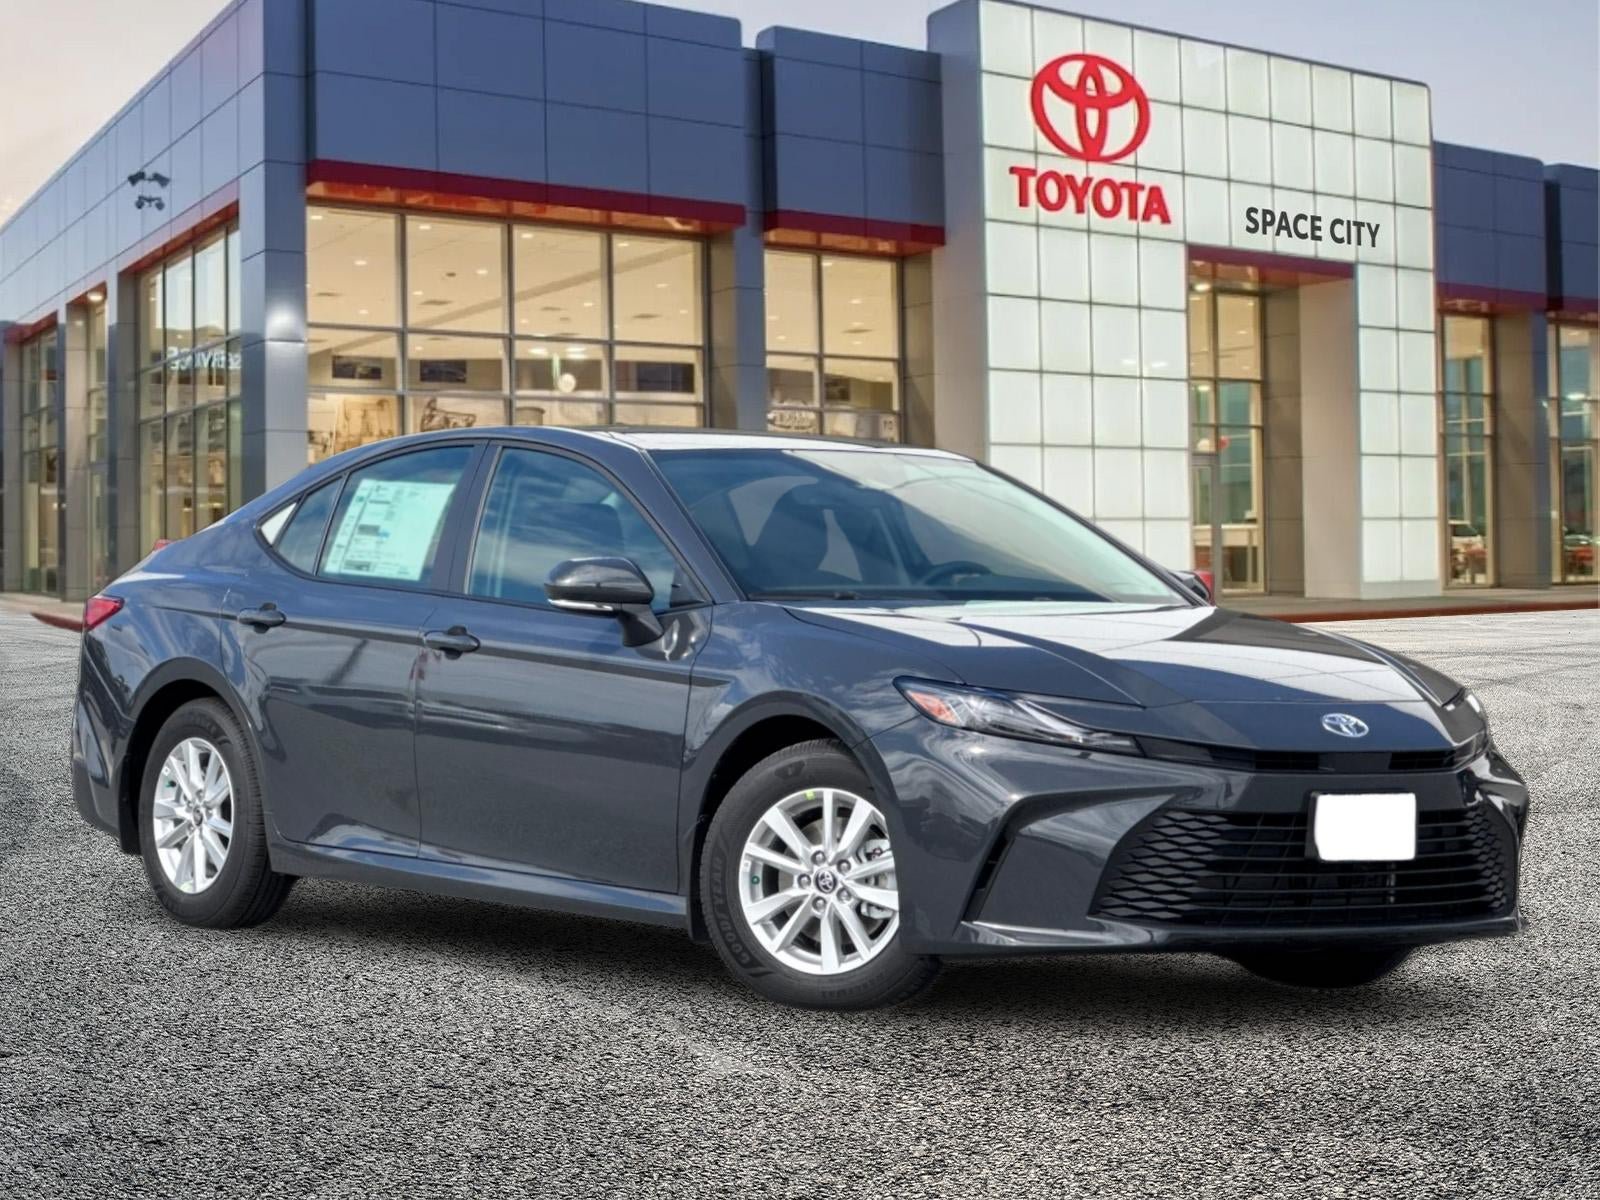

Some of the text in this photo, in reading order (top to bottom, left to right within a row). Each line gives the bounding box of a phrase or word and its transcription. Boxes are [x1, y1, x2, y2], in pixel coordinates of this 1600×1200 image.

[1009, 166, 1171, 224] TOYOTA
[1245, 206, 1380, 248] SPACE CITY
